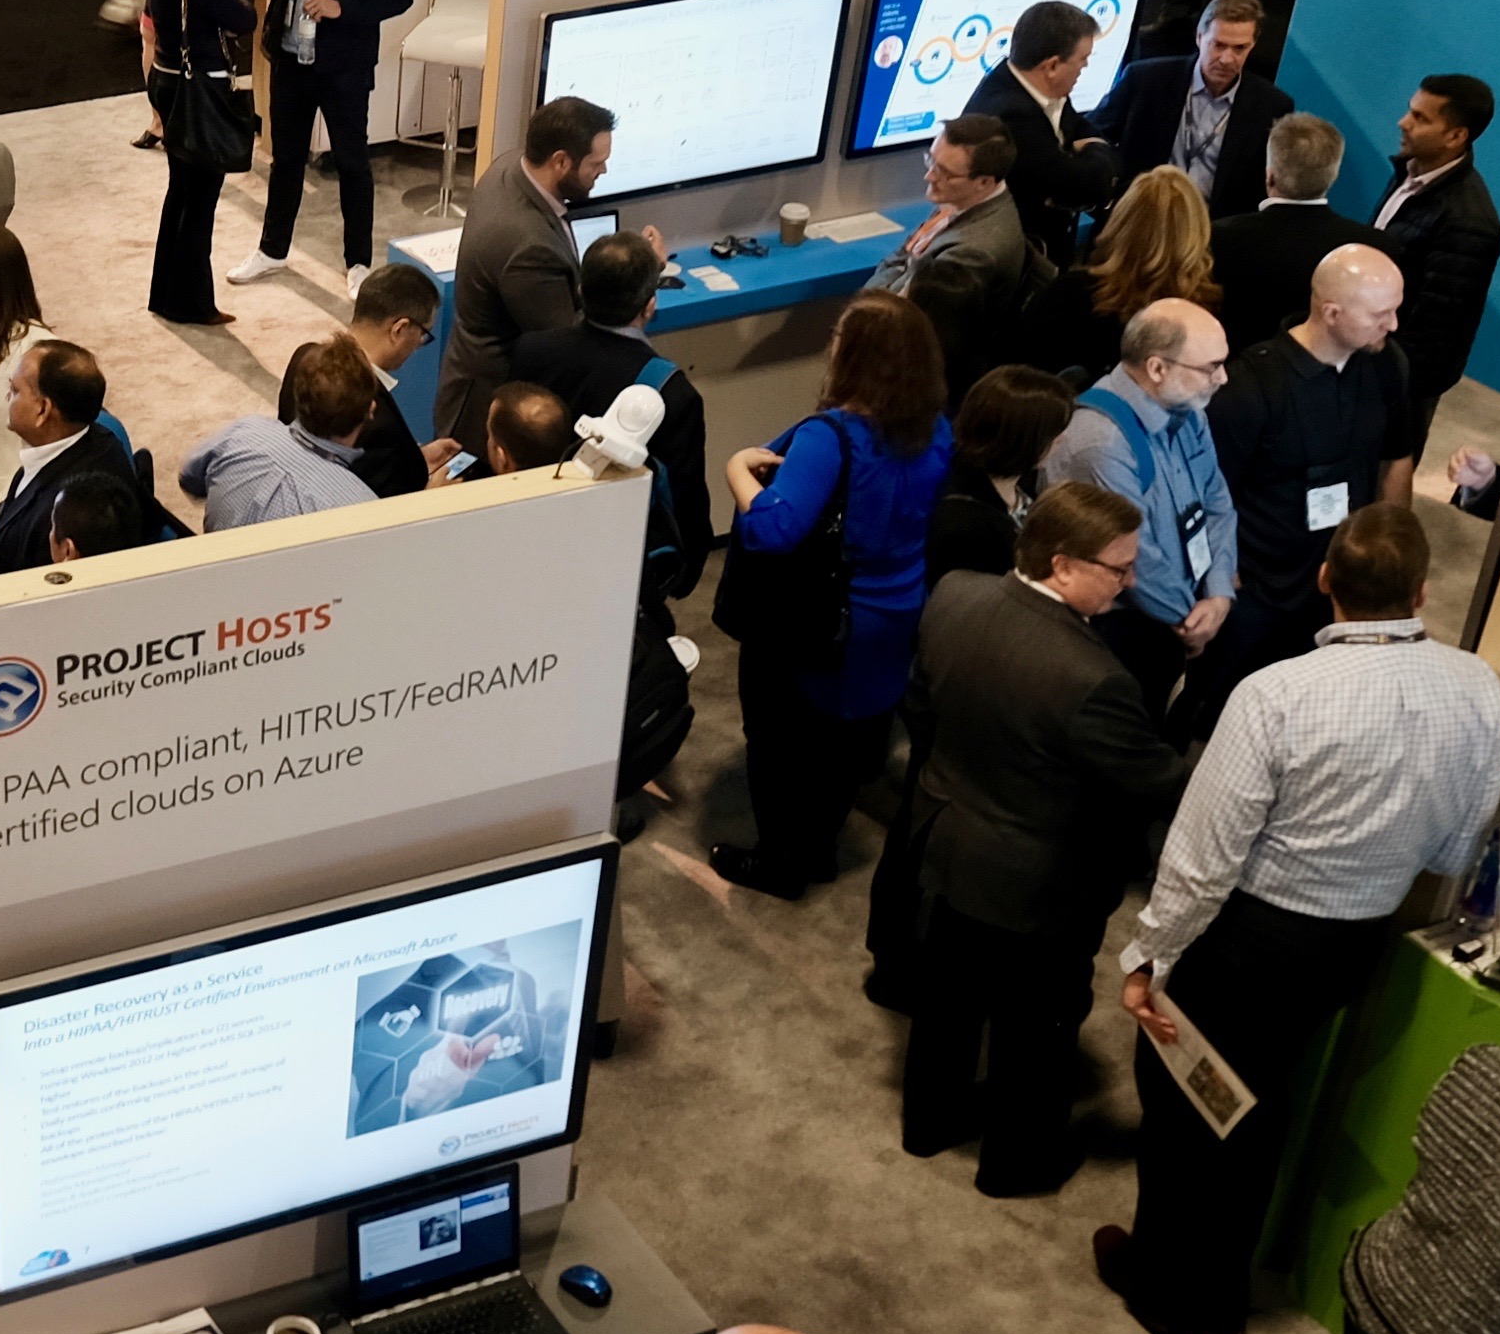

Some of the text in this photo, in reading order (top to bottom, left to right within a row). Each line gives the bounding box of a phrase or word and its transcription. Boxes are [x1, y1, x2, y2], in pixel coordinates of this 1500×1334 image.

[56, 603, 332, 685] PROJECT HOSTS
[80, 725, 249, 777] compliant,
[259, 652, 559, 746] HITRUST/FedRAMP
[24, 1008, 89, 1034] Disaster
[94, 989, 167, 1016] Recovery
[172, 984, 189, 995] as
[207, 963, 263, 987] Service
